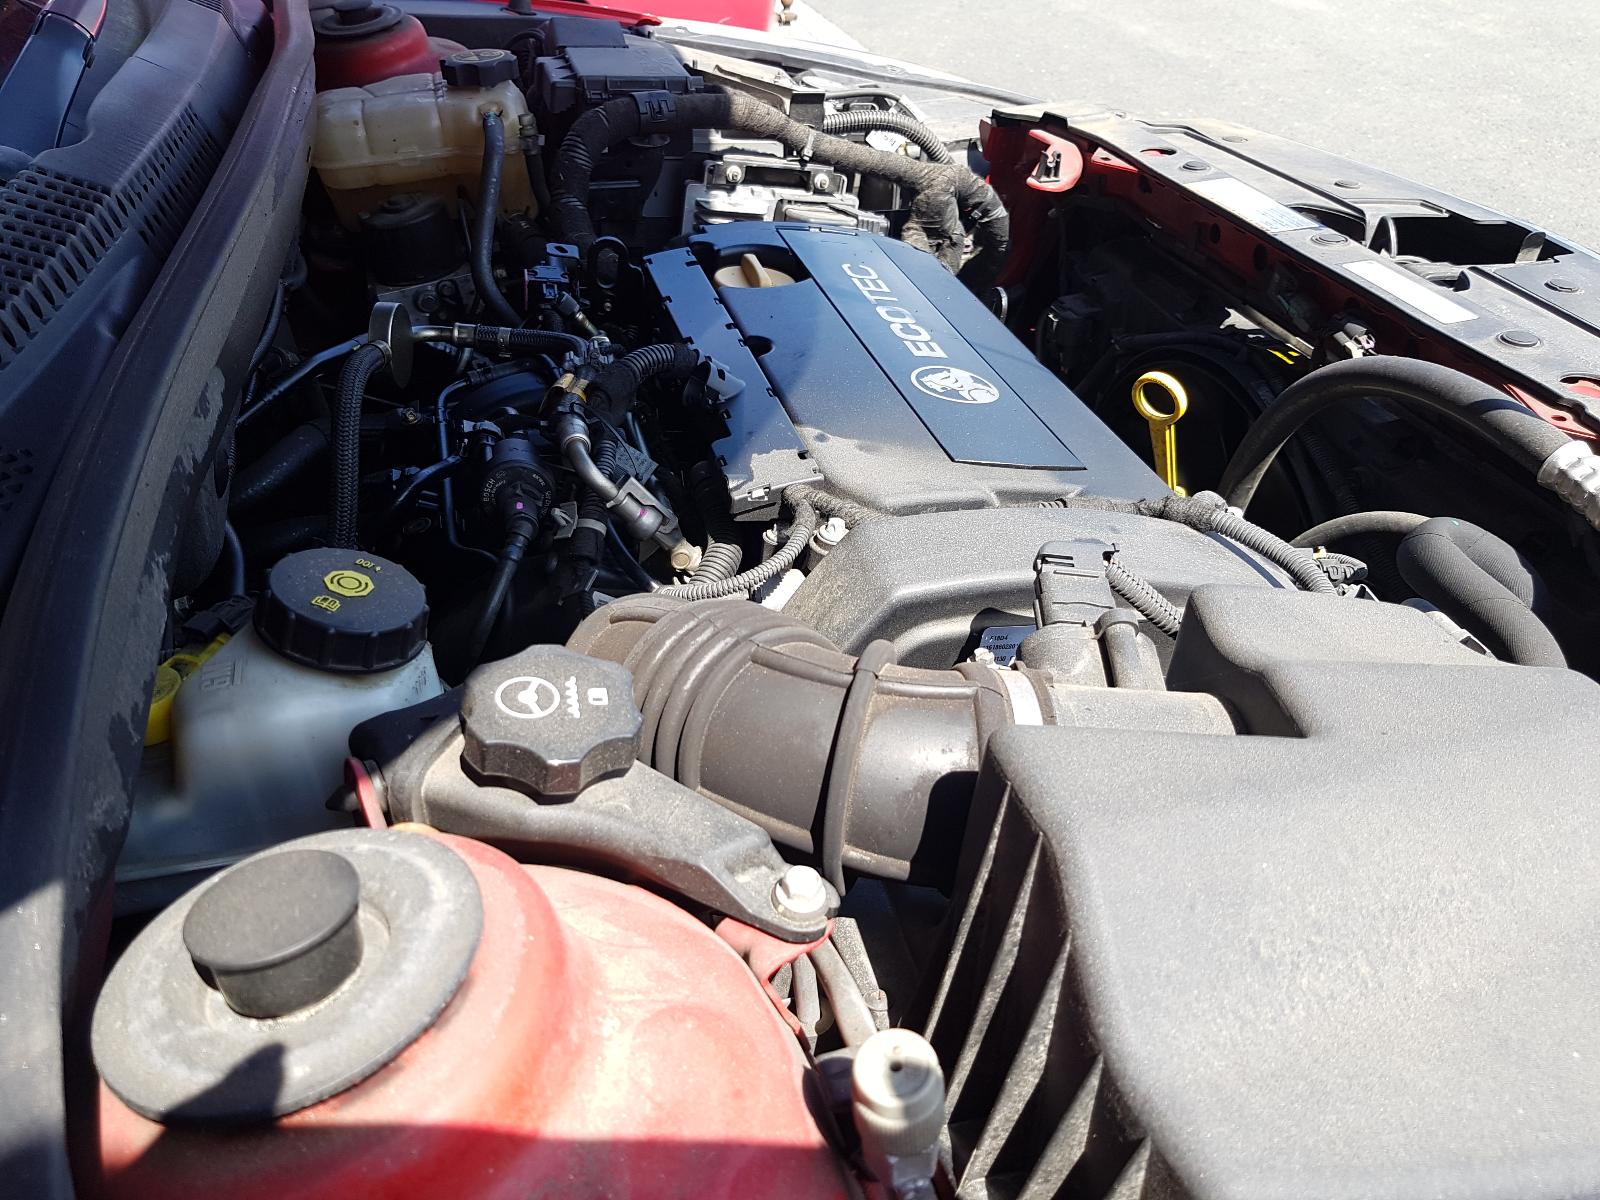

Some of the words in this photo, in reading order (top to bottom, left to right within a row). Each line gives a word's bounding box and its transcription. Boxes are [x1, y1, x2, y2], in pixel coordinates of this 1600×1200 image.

[841, 263, 949, 359] ECOTEC
[483, 478, 496, 502] BOSCH
[355, 558, 375, 569] DOT
